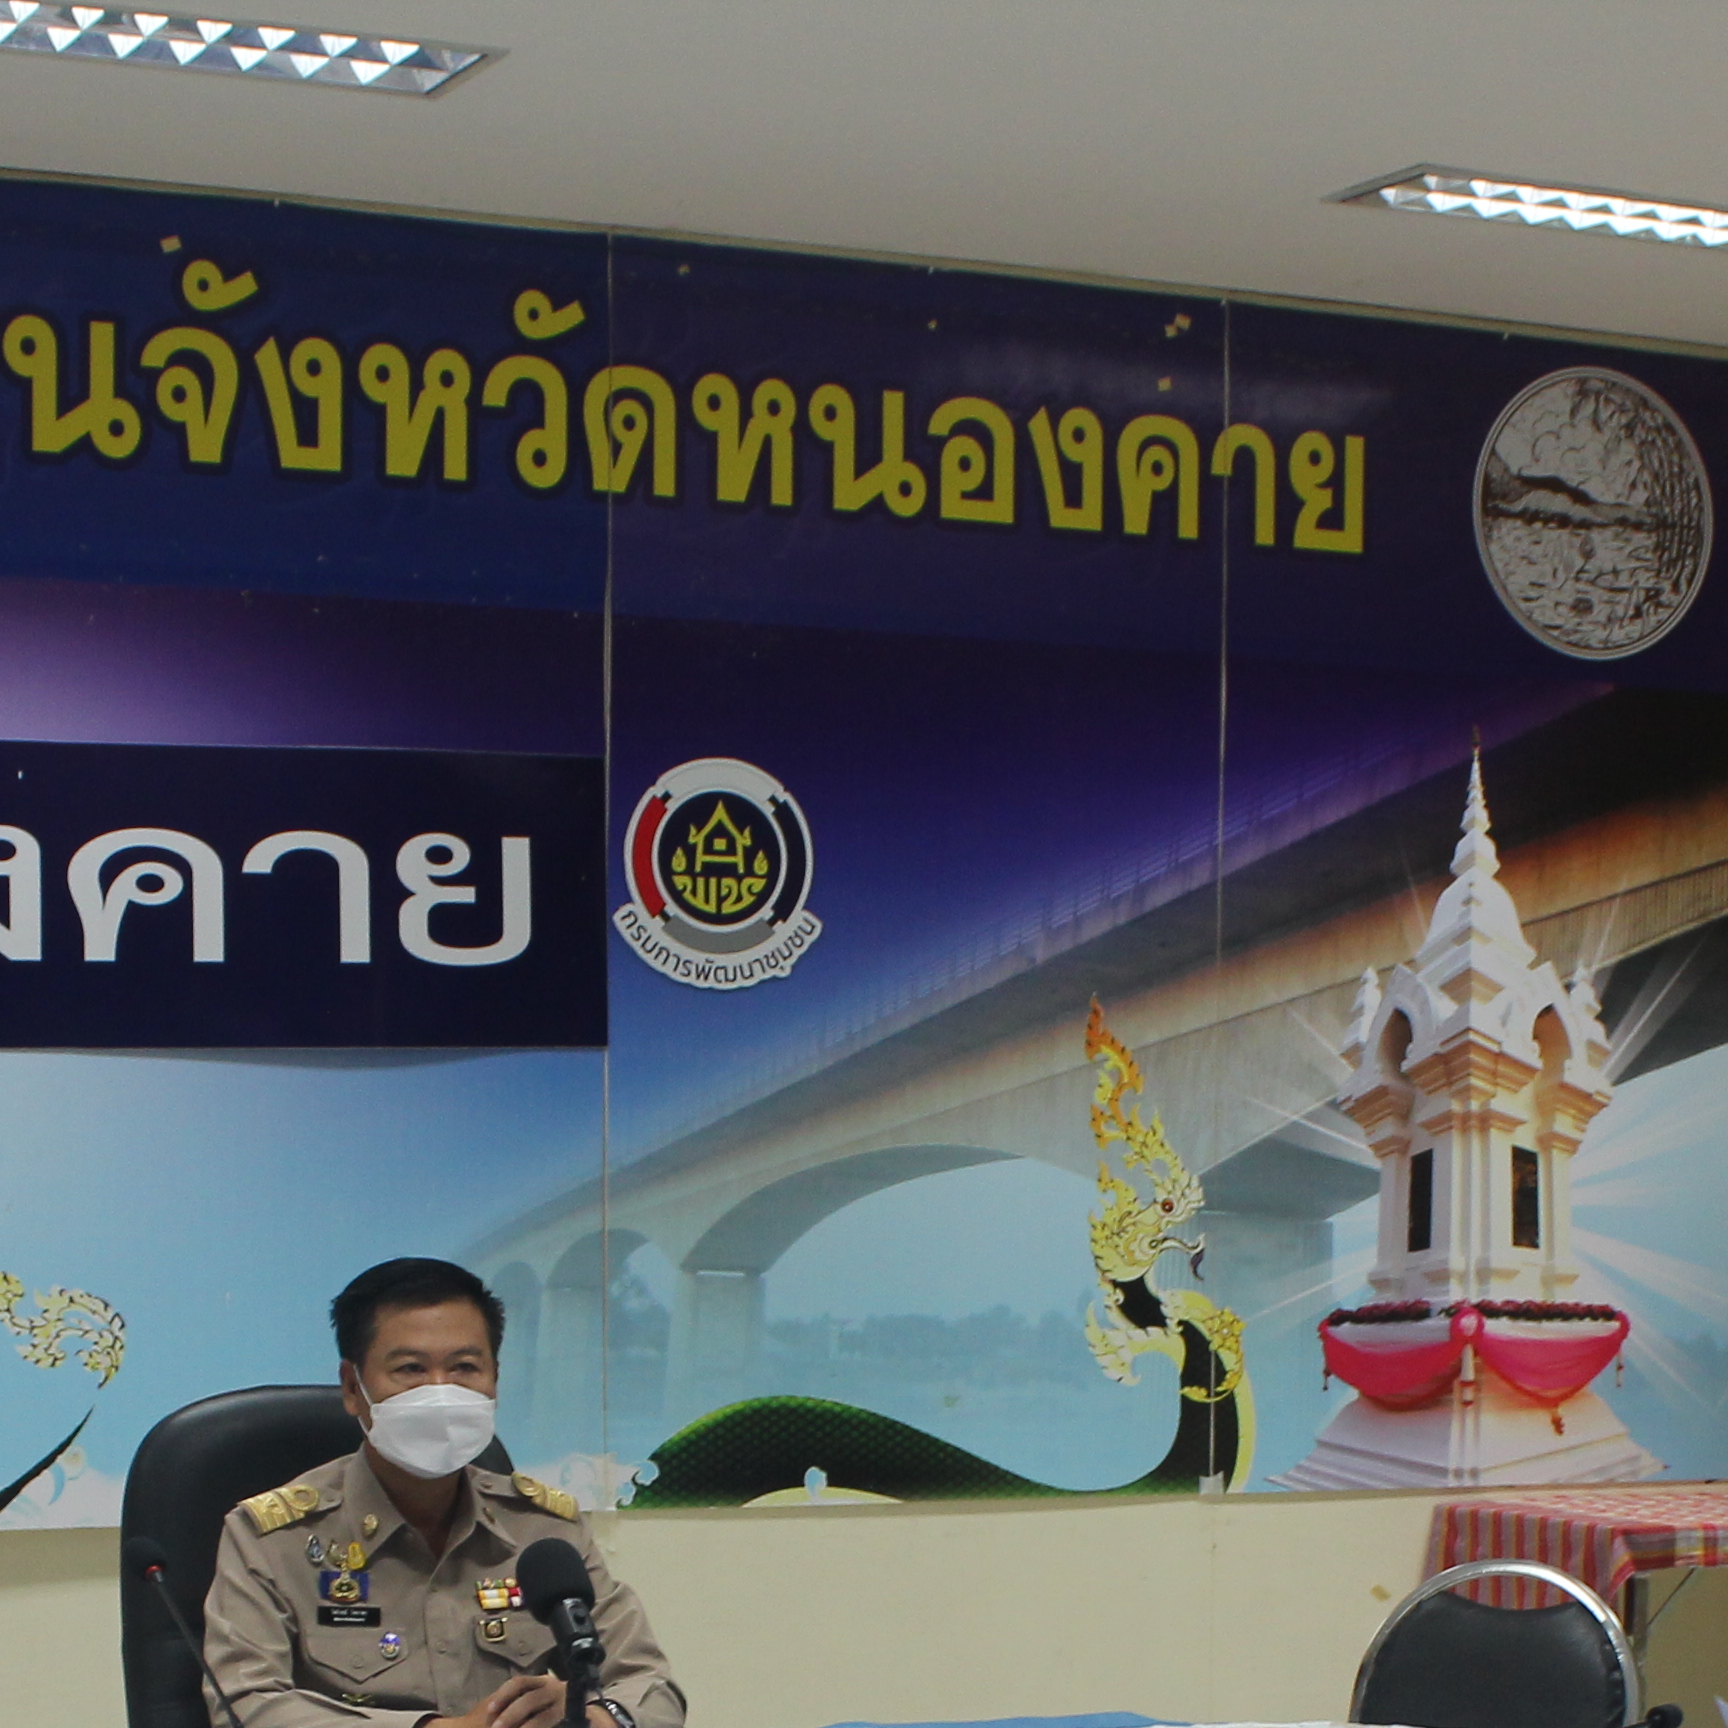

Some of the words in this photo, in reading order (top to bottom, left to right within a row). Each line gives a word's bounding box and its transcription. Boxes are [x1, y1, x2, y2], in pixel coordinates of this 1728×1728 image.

[618, 909, 818, 984] กรมการพัฒนาชุมชน
